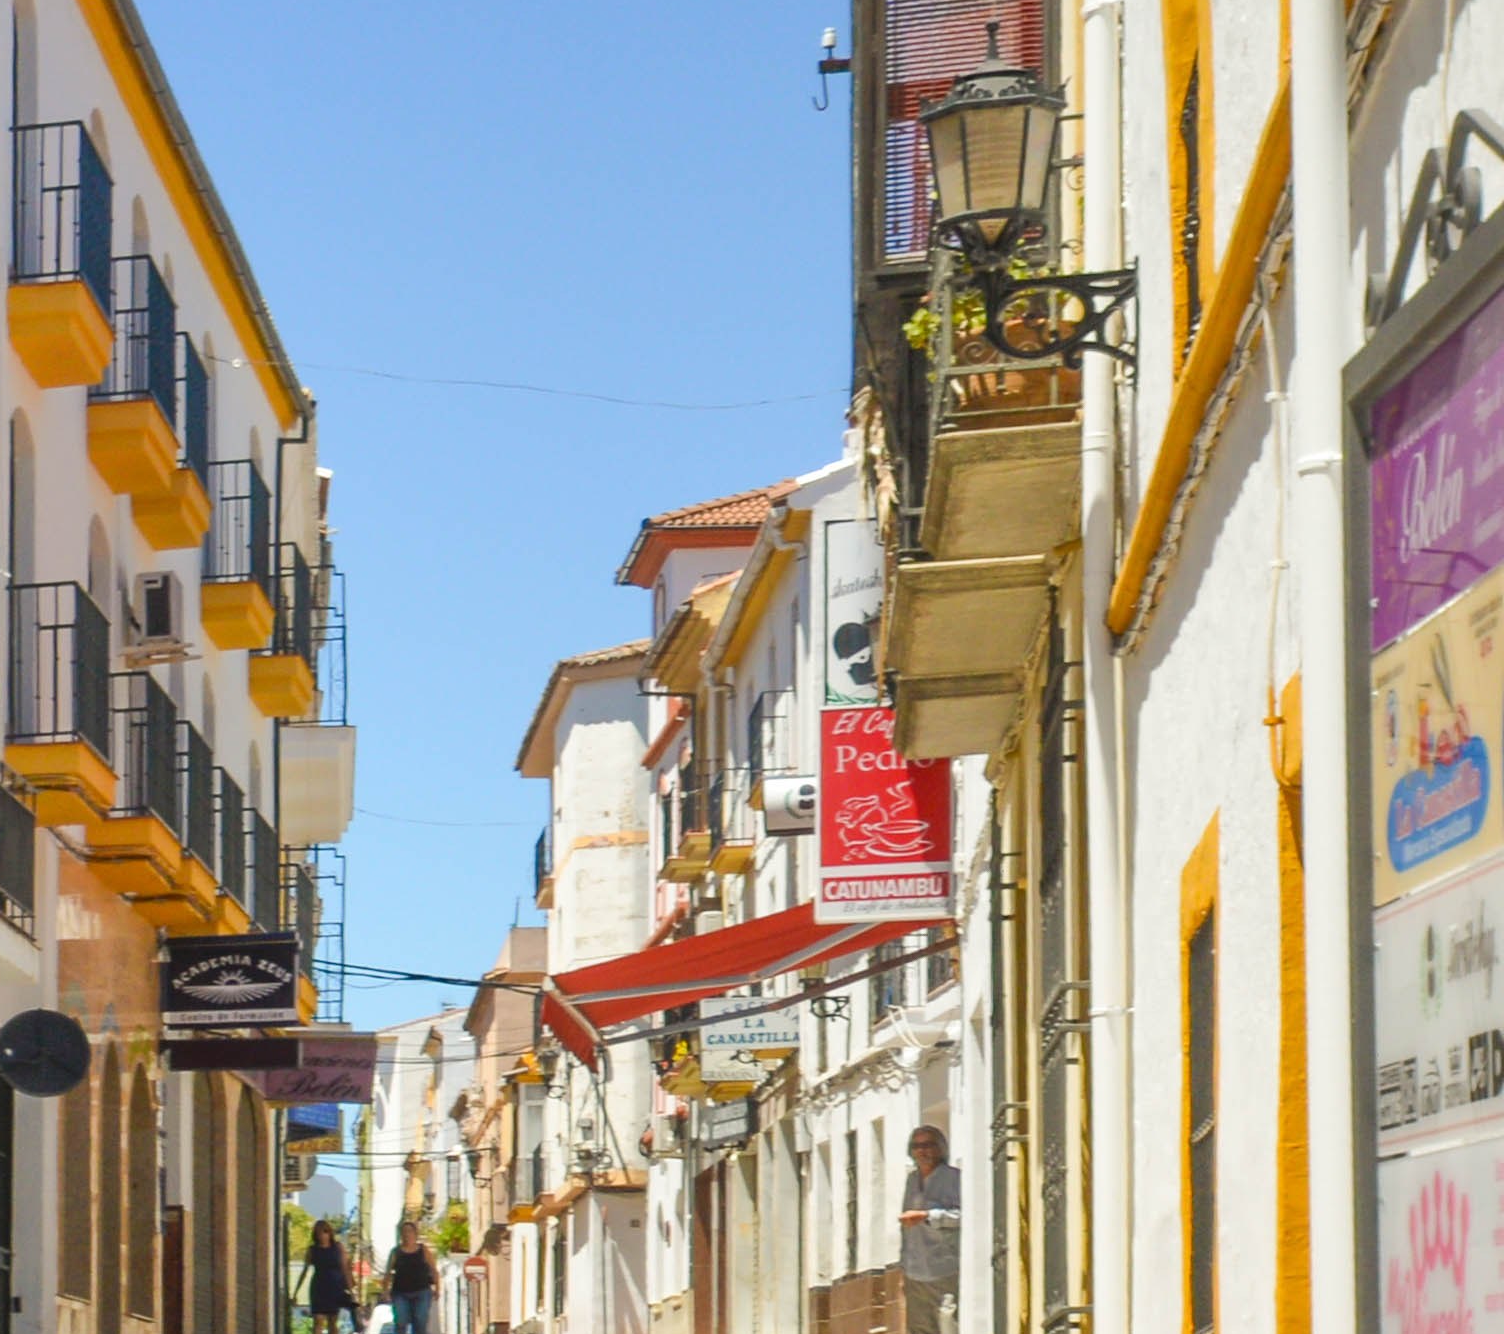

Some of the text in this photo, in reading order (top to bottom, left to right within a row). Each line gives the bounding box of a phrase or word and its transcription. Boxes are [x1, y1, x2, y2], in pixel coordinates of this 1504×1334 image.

[171, 954, 294, 990] ACADEMIA ZEUS
[743, 1018, 766, 1029] LA
[706, 1031, 801, 1045] CANASTILLA
